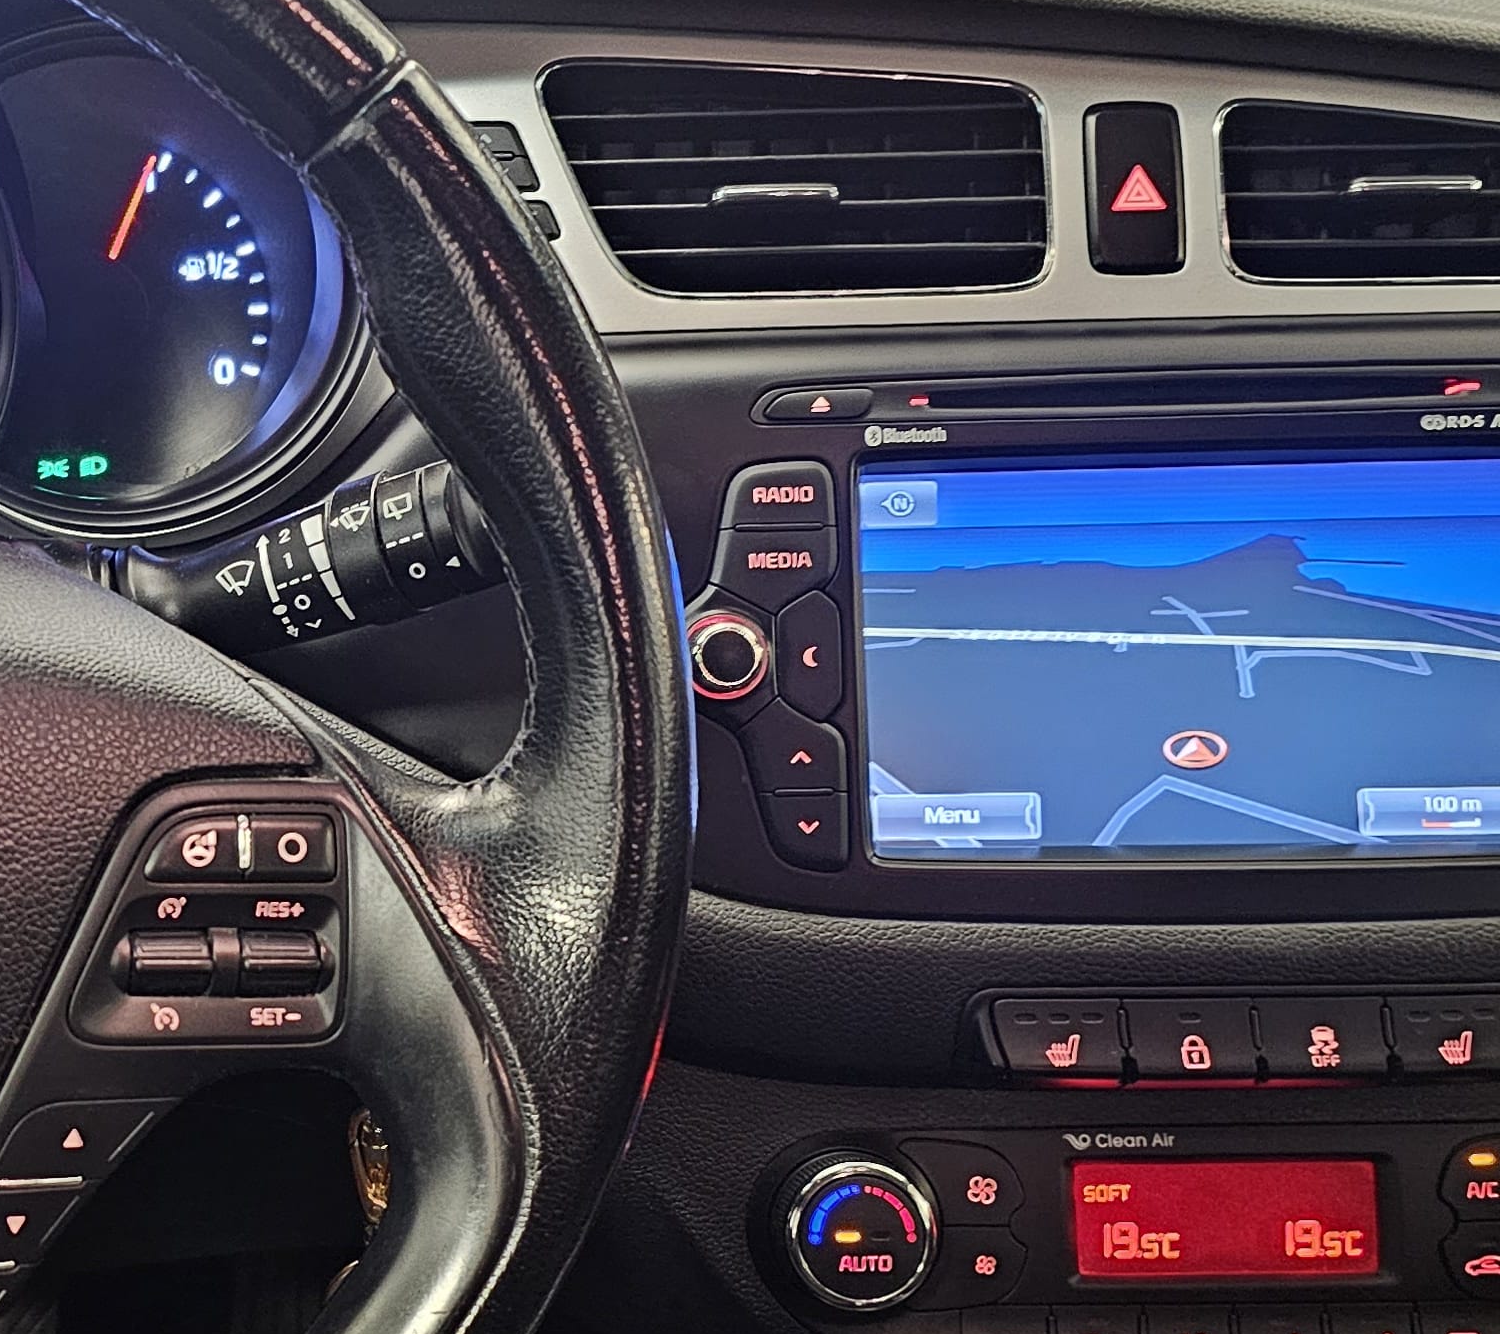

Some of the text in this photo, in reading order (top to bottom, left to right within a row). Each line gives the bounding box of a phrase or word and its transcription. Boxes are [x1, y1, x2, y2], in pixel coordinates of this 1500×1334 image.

[205, 251, 239, 280] 1/2
[214, 357, 235, 385] 0
[882, 427, 947, 443] Bluetooth
[752, 485, 814, 504] RADIO
[892, 496, 909, 511] N
[277, 529, 292, 545] 2
[282, 552, 294, 569] 1
[748, 551, 813, 569] MEDIA
[1423, 795, 1483, 813] 100 m
[924, 805, 980, 824] Menu
[255, 900, 305, 919] RES+
[1311, 1054, 1341, 1068] OFF
[1095, 1132, 1176, 1149] Clean Air
[1083, 1183, 1132, 1203] SOFT
[1466, 1181, 1500, 1199] A/C
[839, 1254, 893, 1273] AUTO
